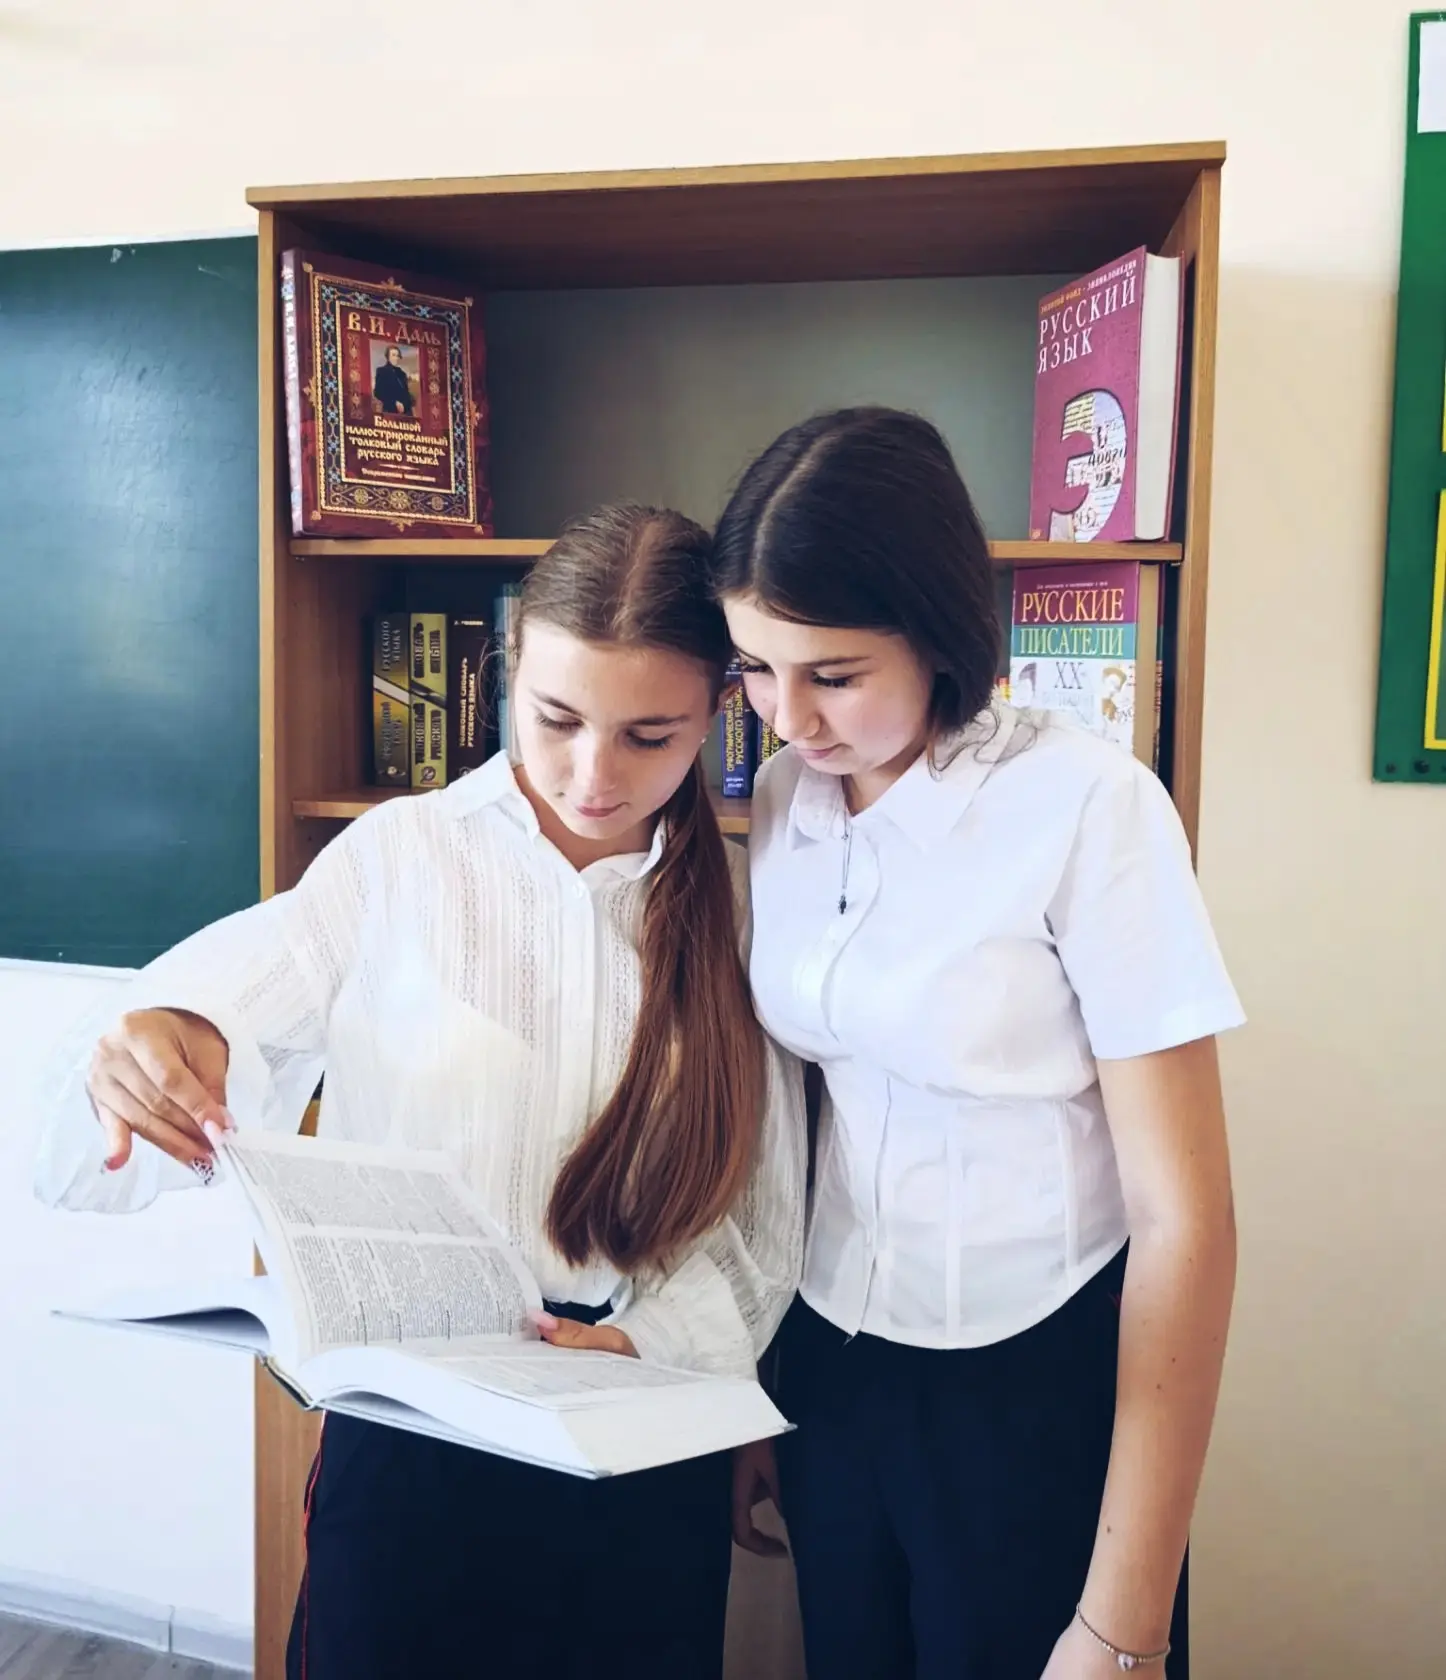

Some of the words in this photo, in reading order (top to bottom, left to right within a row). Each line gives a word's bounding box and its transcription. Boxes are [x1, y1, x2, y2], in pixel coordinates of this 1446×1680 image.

[1040, 269, 1136, 345] РУССКИЙ
[368, 314, 391, 337] И.
[395, 320, 442, 345] Даль
[1038, 327, 1093, 374] ЯЗЫК
[374, 415, 421, 432] Большой
[1021, 588, 1125, 623] РУССКИЕ
[1020, 627, 1124, 656] ПИСАТЕЛИ
[735, 719, 744, 765] РУССКОГО
